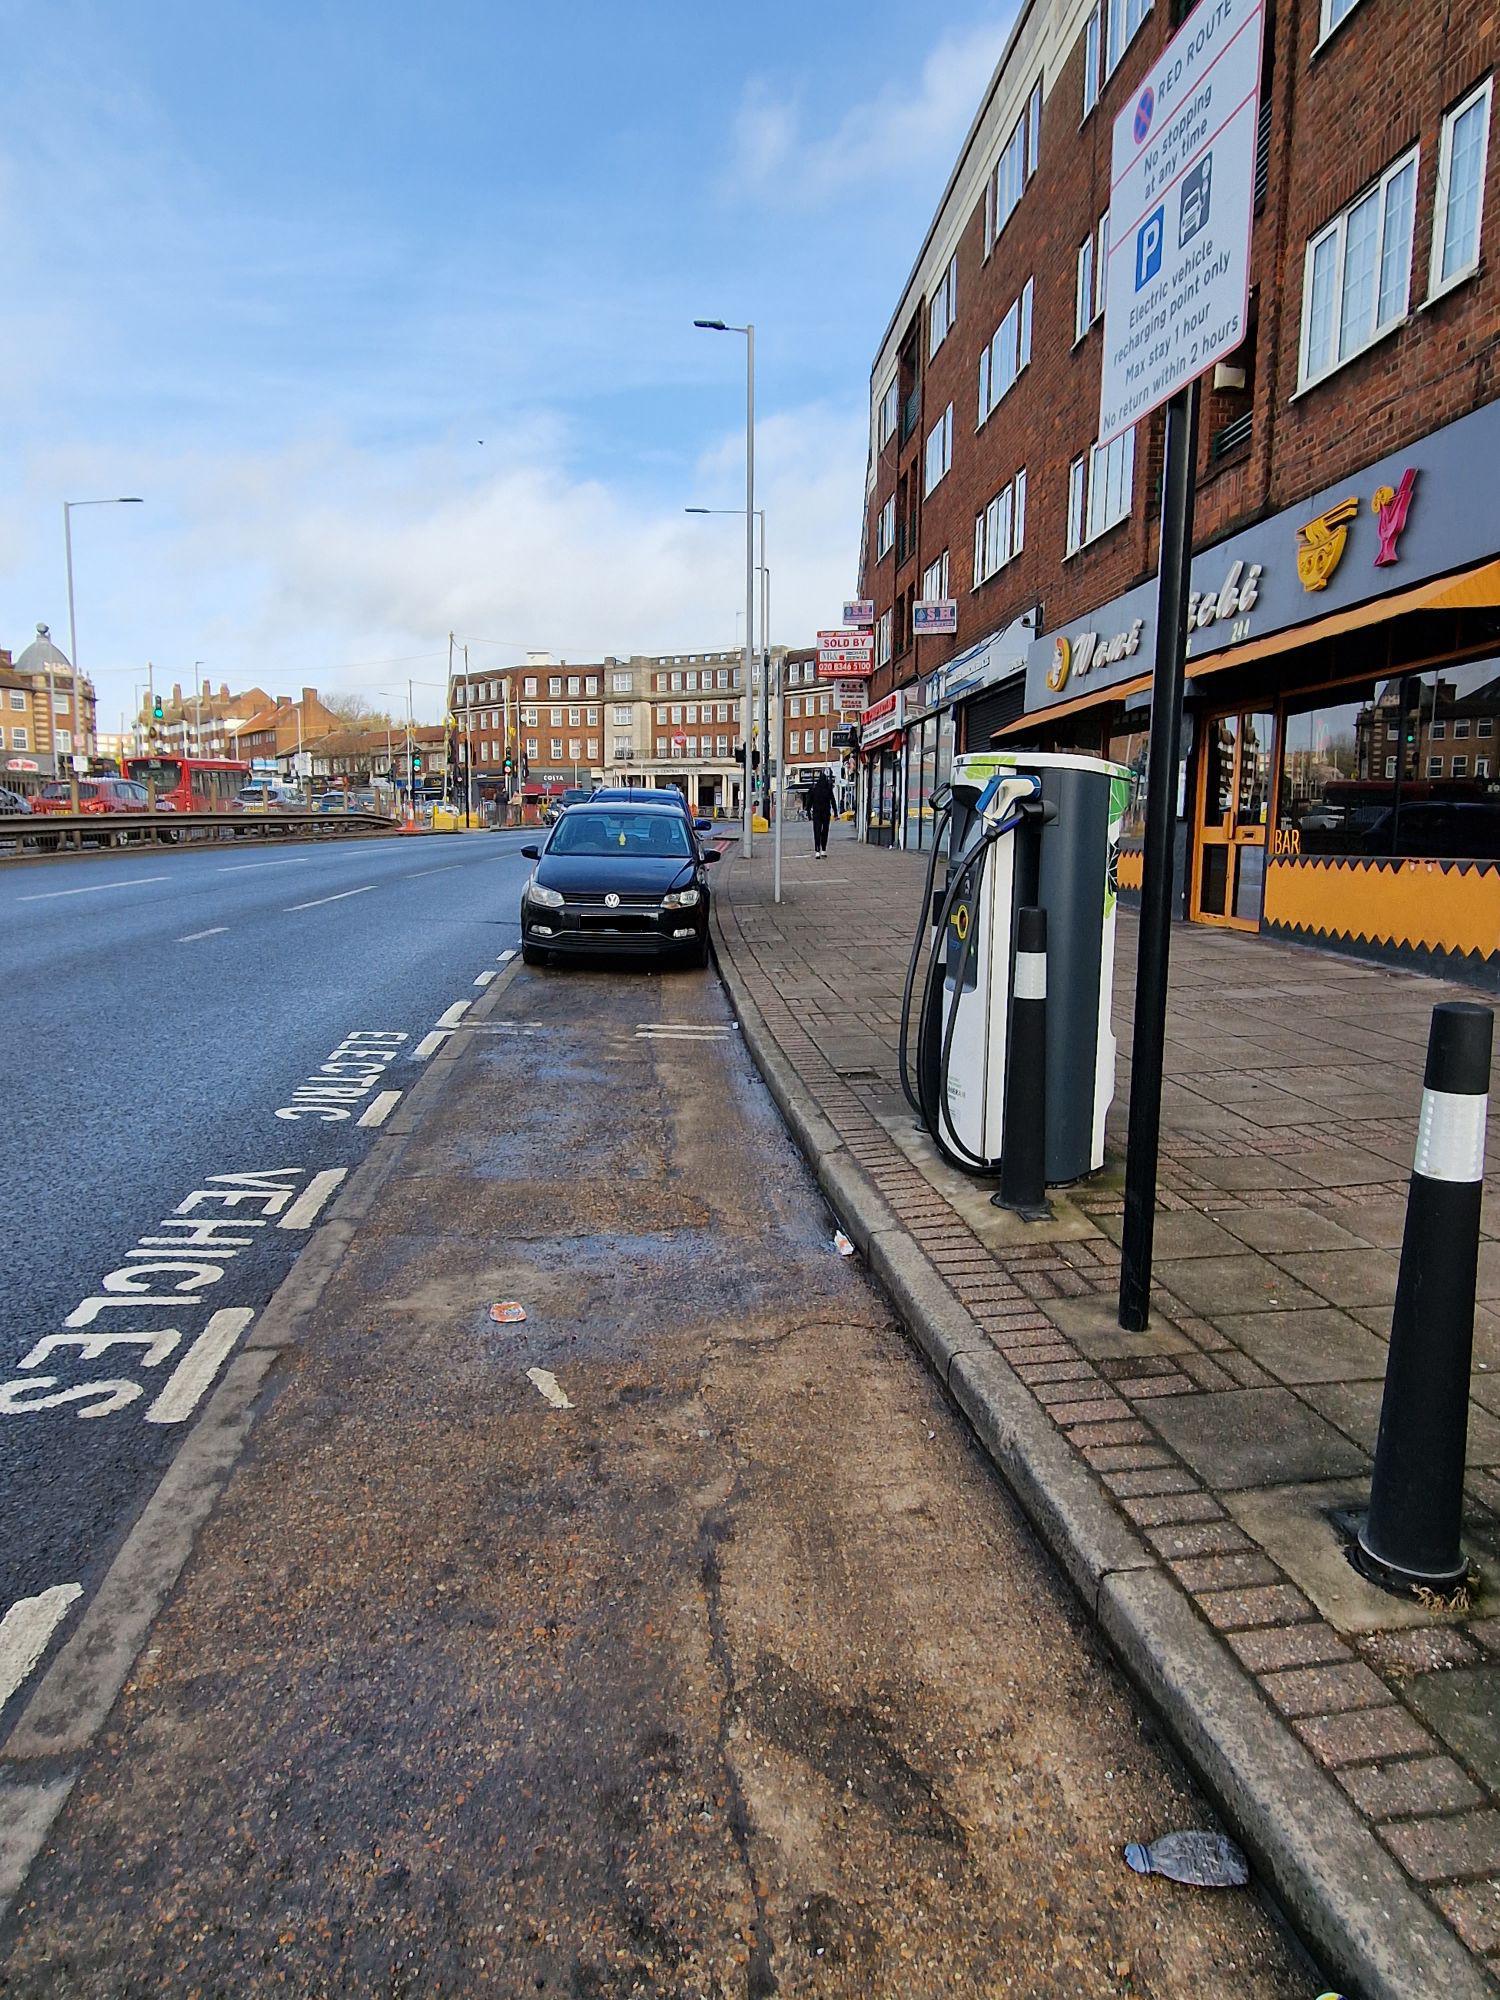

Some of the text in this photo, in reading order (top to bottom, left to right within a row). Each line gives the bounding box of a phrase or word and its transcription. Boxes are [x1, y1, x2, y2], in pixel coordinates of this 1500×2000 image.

[1157, 0, 1232, 104] RED ROUTE
[1144, 84, 1212, 177] No stopping
[1144, 118, 1208, 200] at any time
[1129, 239, 1214, 329] Electric vehicle
[1140, 218, 1161, 283] P
[1113, 249, 1232, 367] recharging point only
[1125, 359, 1146, 387] Max
[1148, 336, 1172, 368] stay
[1182, 301, 1212, 339] hour
[1102, 313, 1240, 433] No return within 2 hours
[819, 661, 871, 671] 020 8346 5100
[824, 638, 867, 648] SOLD BY
[1274, 829, 1300, 854] BAR
[0, 1031, 409, 1419] ELECTRIC VEHICLES
